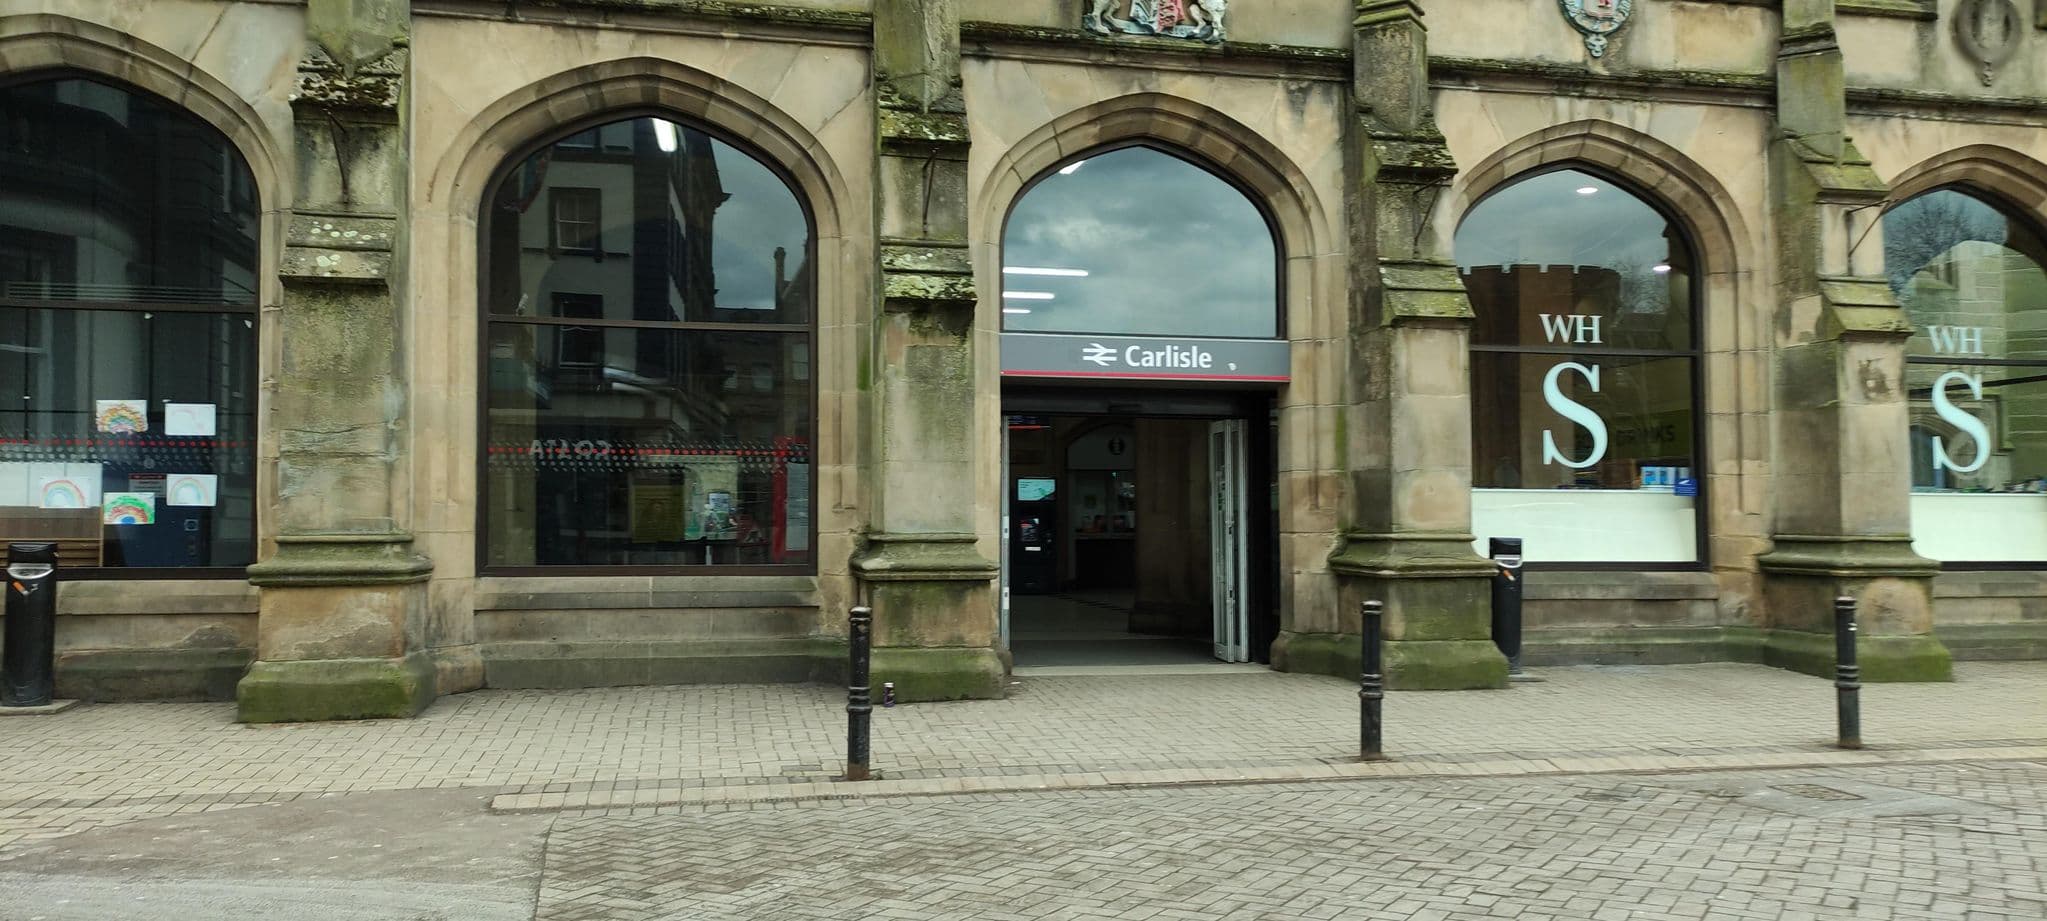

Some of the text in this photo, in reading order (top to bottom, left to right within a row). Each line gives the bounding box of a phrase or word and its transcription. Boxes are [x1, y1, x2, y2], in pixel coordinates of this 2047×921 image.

[1539, 313, 1603, 344] WH
[1926, 325, 1984, 354] WH
[1124, 344, 1213, 369] Carlisle
[1543, 361, 1608, 468] S
[1931, 371, 1991, 473] S
